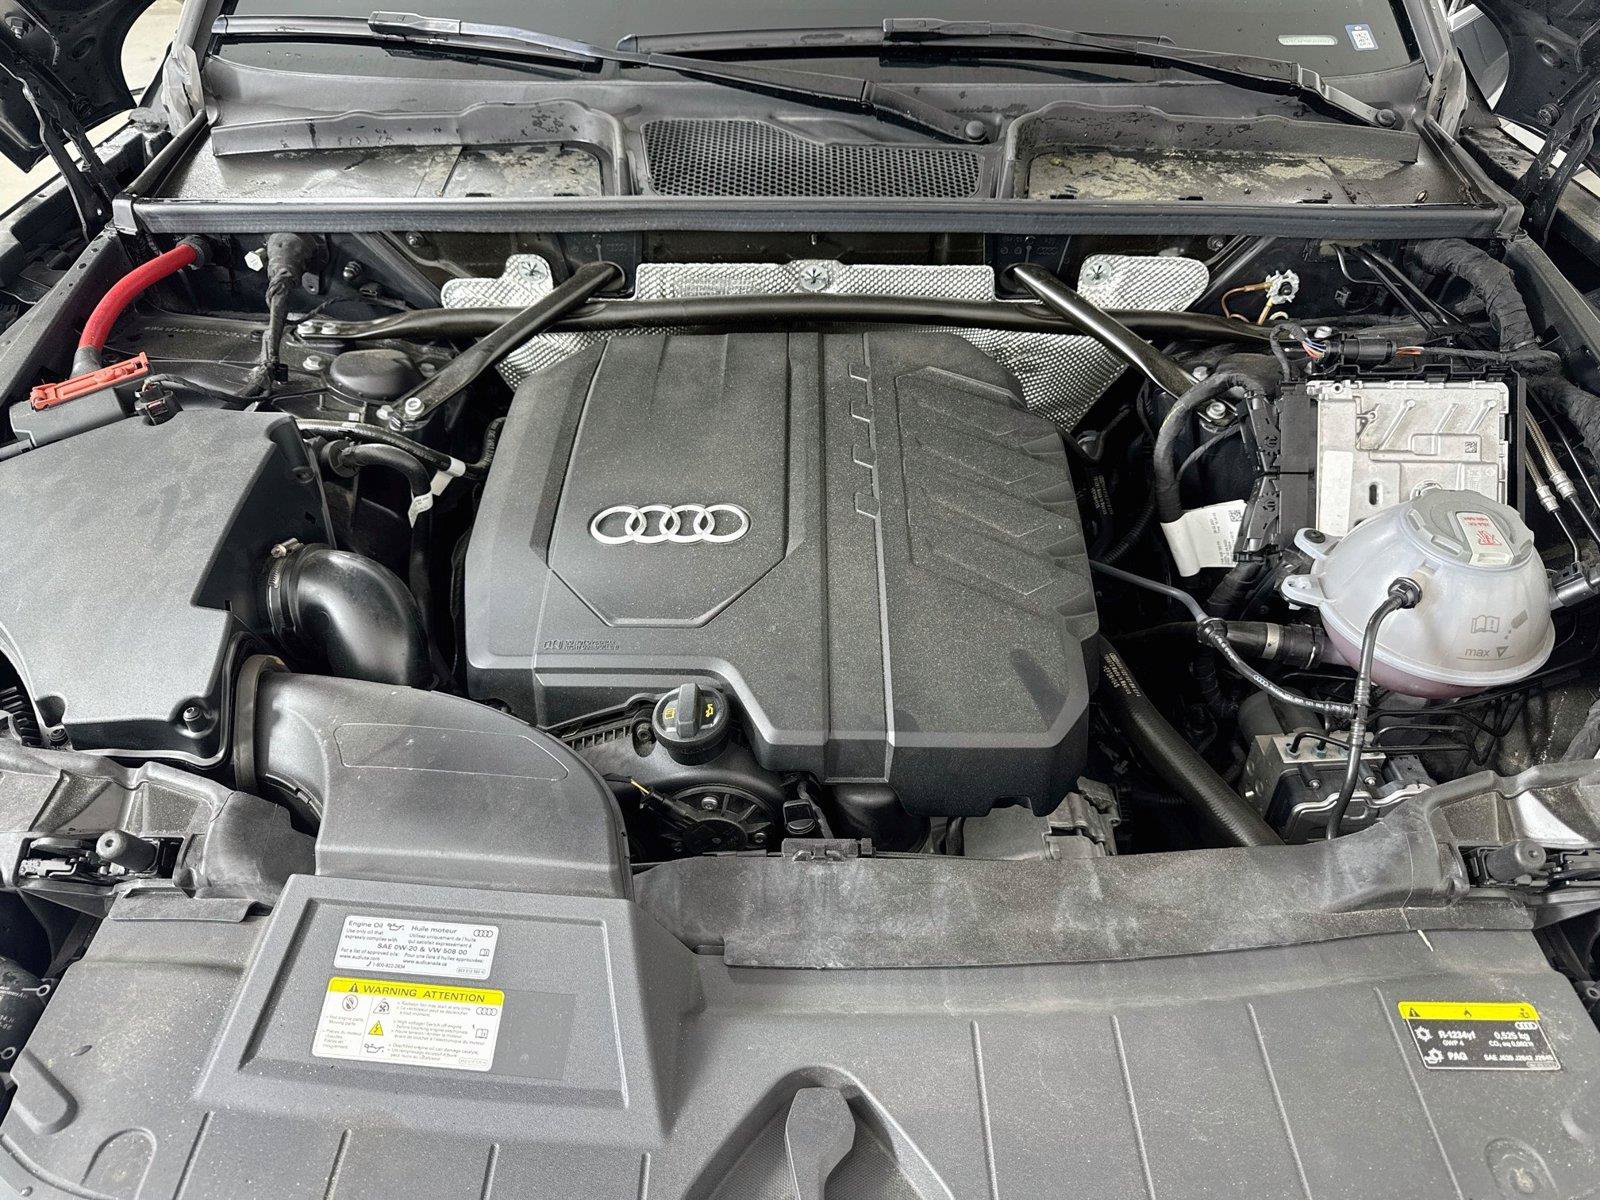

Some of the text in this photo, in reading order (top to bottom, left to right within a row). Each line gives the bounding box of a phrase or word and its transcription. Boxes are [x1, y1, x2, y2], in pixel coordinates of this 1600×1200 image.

[1464, 648, 1490, 656] max
[363, 985, 485, 1002] WARNING ATTENTION
[1519, 1032, 1530, 1041] kg
[1447, 1052, 1468, 1060] PAG
